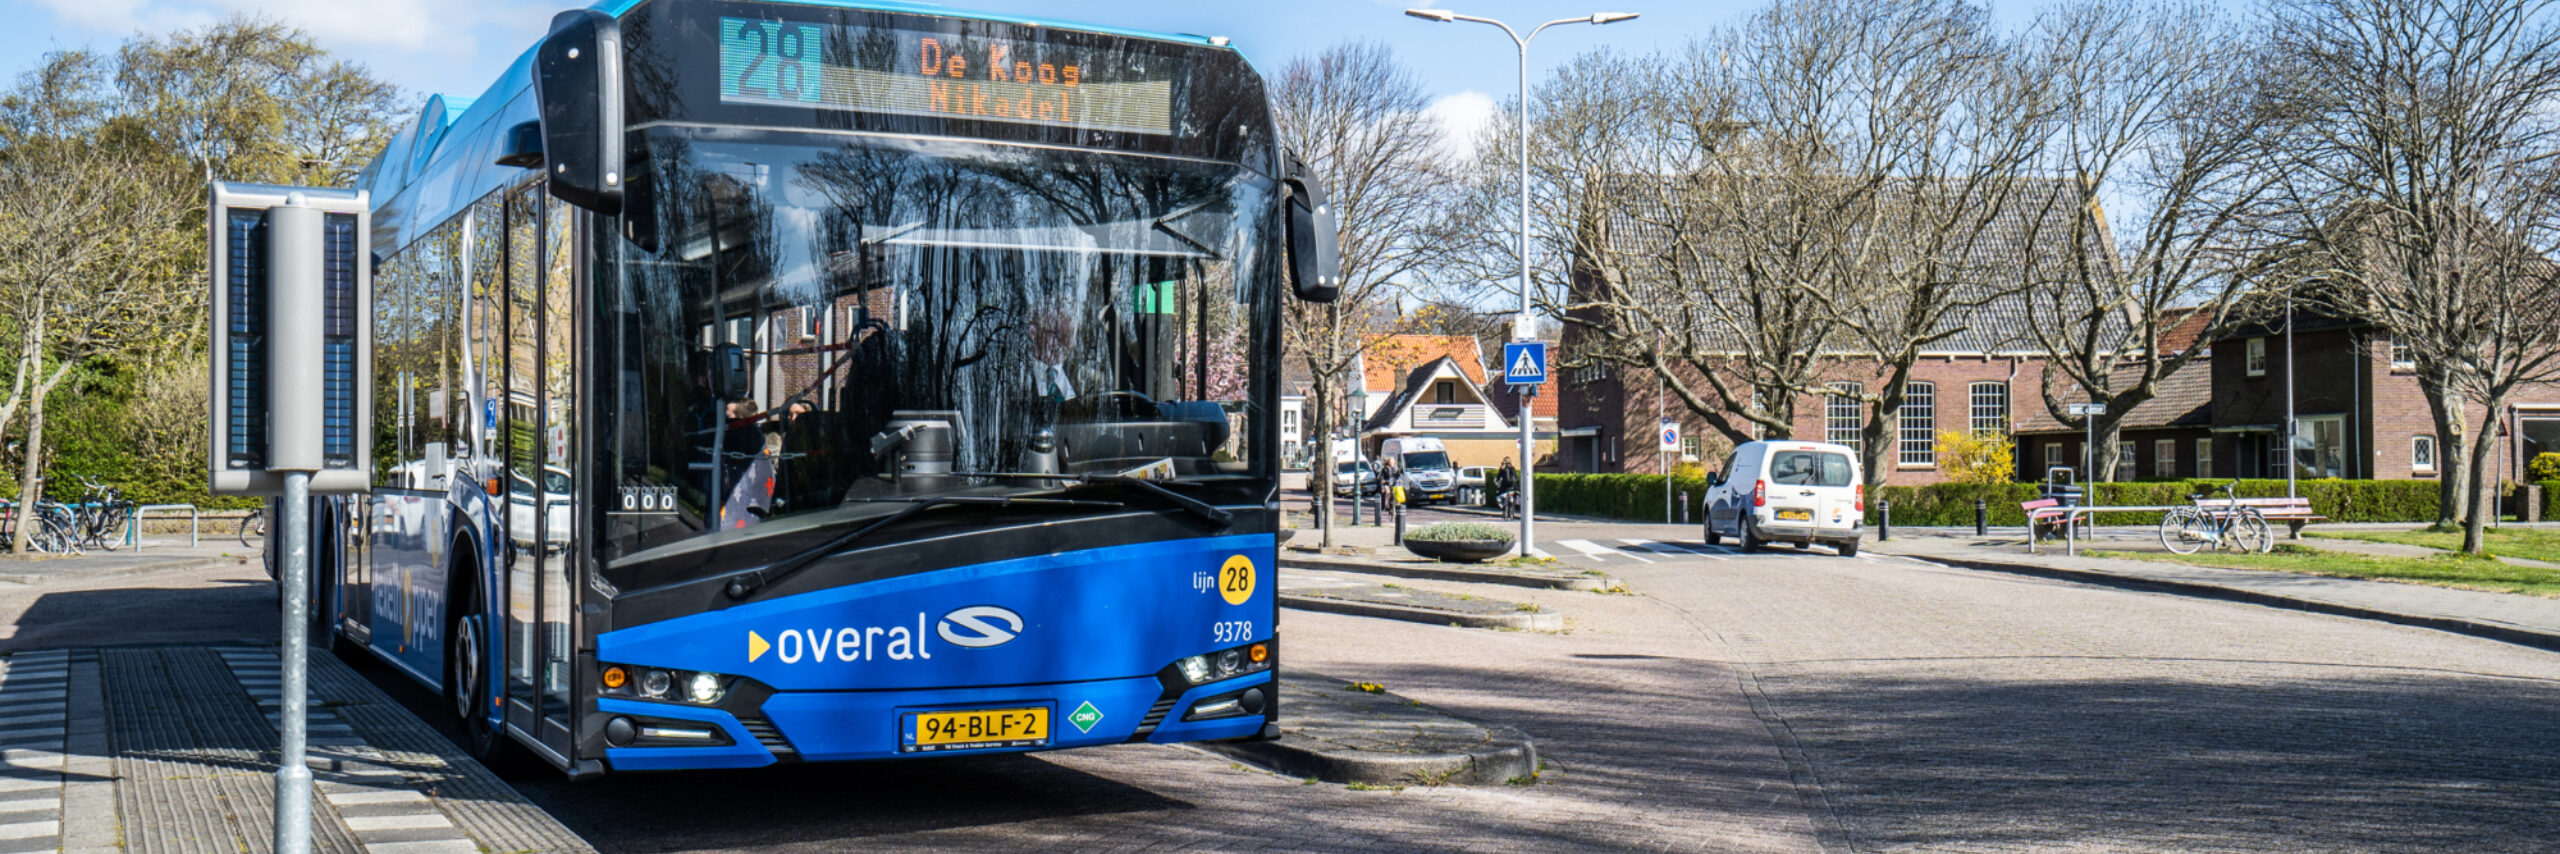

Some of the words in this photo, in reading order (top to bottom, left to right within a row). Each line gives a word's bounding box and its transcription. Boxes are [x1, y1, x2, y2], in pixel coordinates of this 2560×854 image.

[738, 19, 804, 100] 28
[921, 38, 966, 78] De
[990, 44, 1080, 87] Koog
[930, 80, 1071, 122] Nikadel
[1193, 571, 1215, 594] lijn
[1226, 566, 1249, 592] 28
[778, 612, 931, 664] overal
[1213, 620, 1252, 643] 9378
[926, 713, 1036, 740] 94-BLF-2
[1076, 712, 1095, 721] CNG
